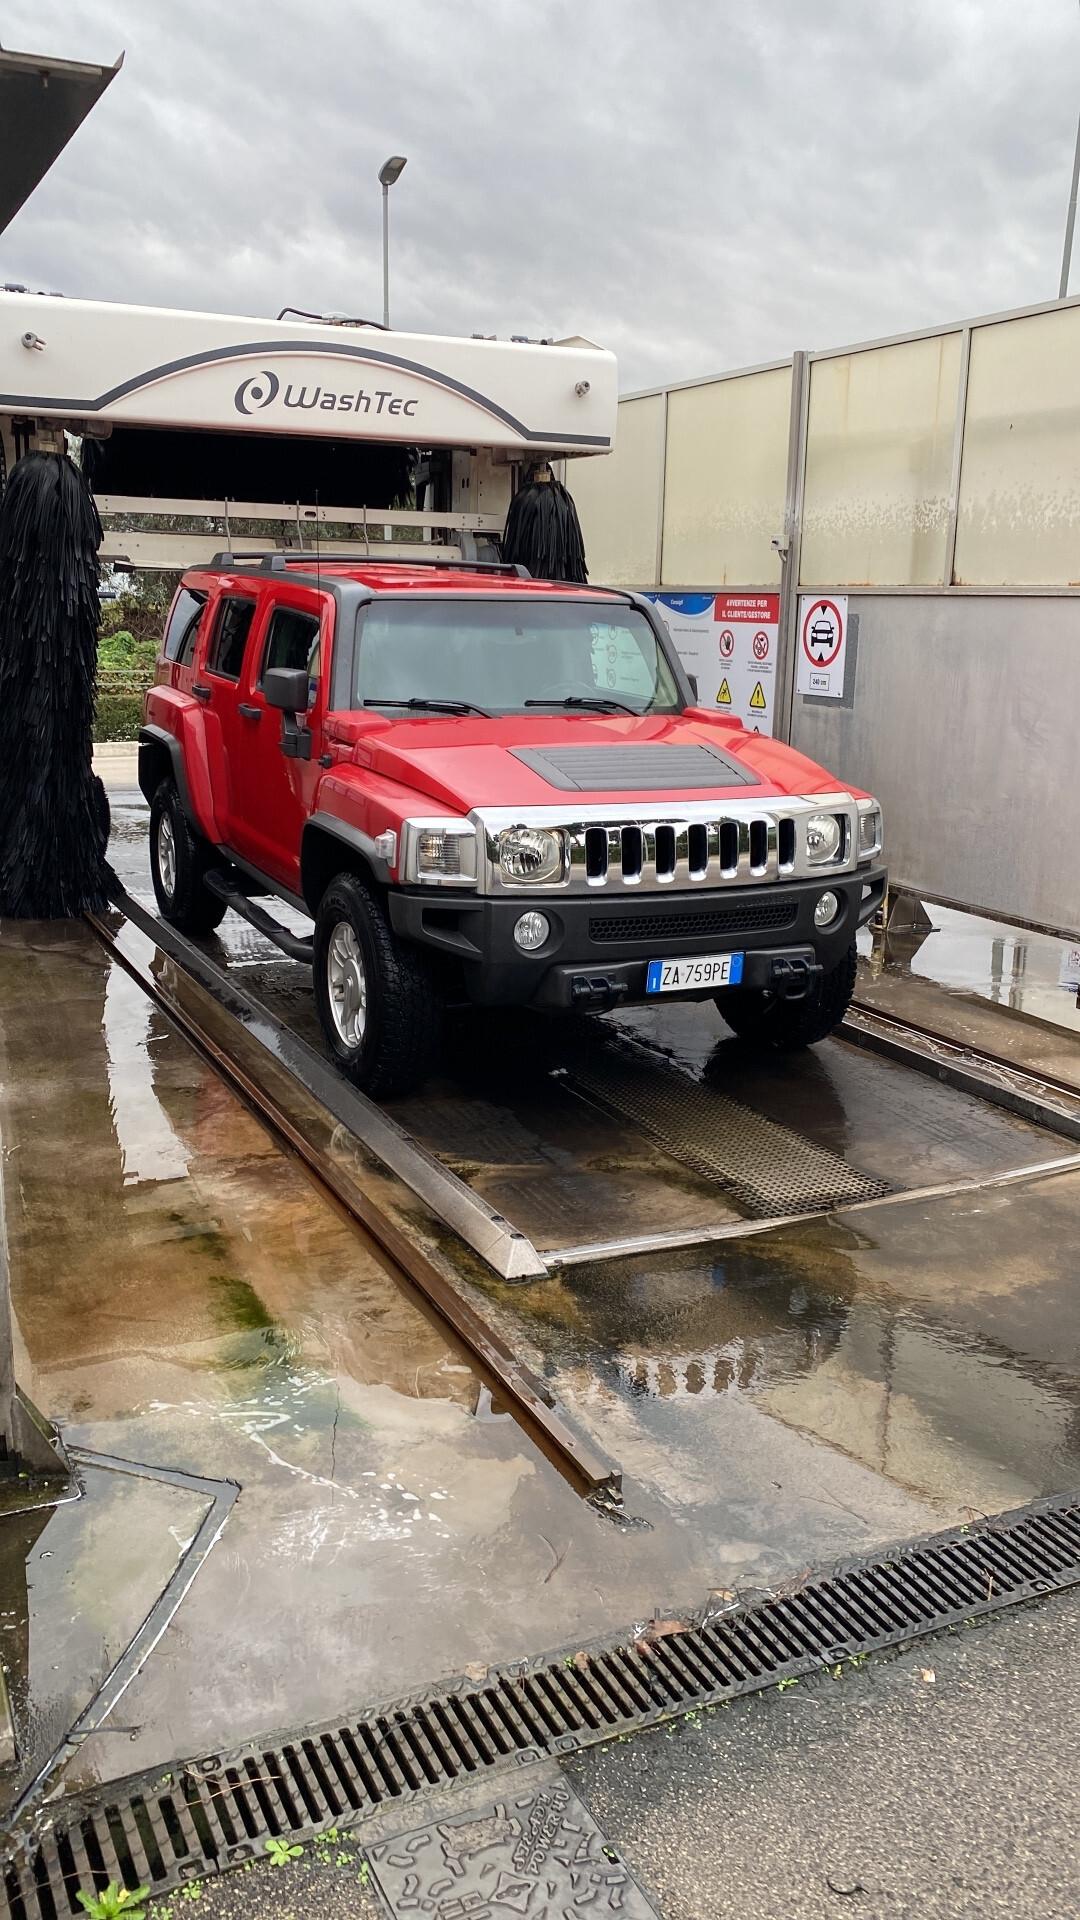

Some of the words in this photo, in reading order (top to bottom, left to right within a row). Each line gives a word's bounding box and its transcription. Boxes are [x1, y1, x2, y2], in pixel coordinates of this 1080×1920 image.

[283, 385, 419, 417] WashTec
[721, 610, 727, 618] IL
[727, 610, 771, 619] CLIENTE/GESTORE
[726, 599, 757, 608] AVVERTENZE
[757, 600, 768, 608] PER
[685, 961, 730, 983] 759PE
[512, 1792, 552, 1872] STEADY
[525, 1813, 562, 1875] POWER
